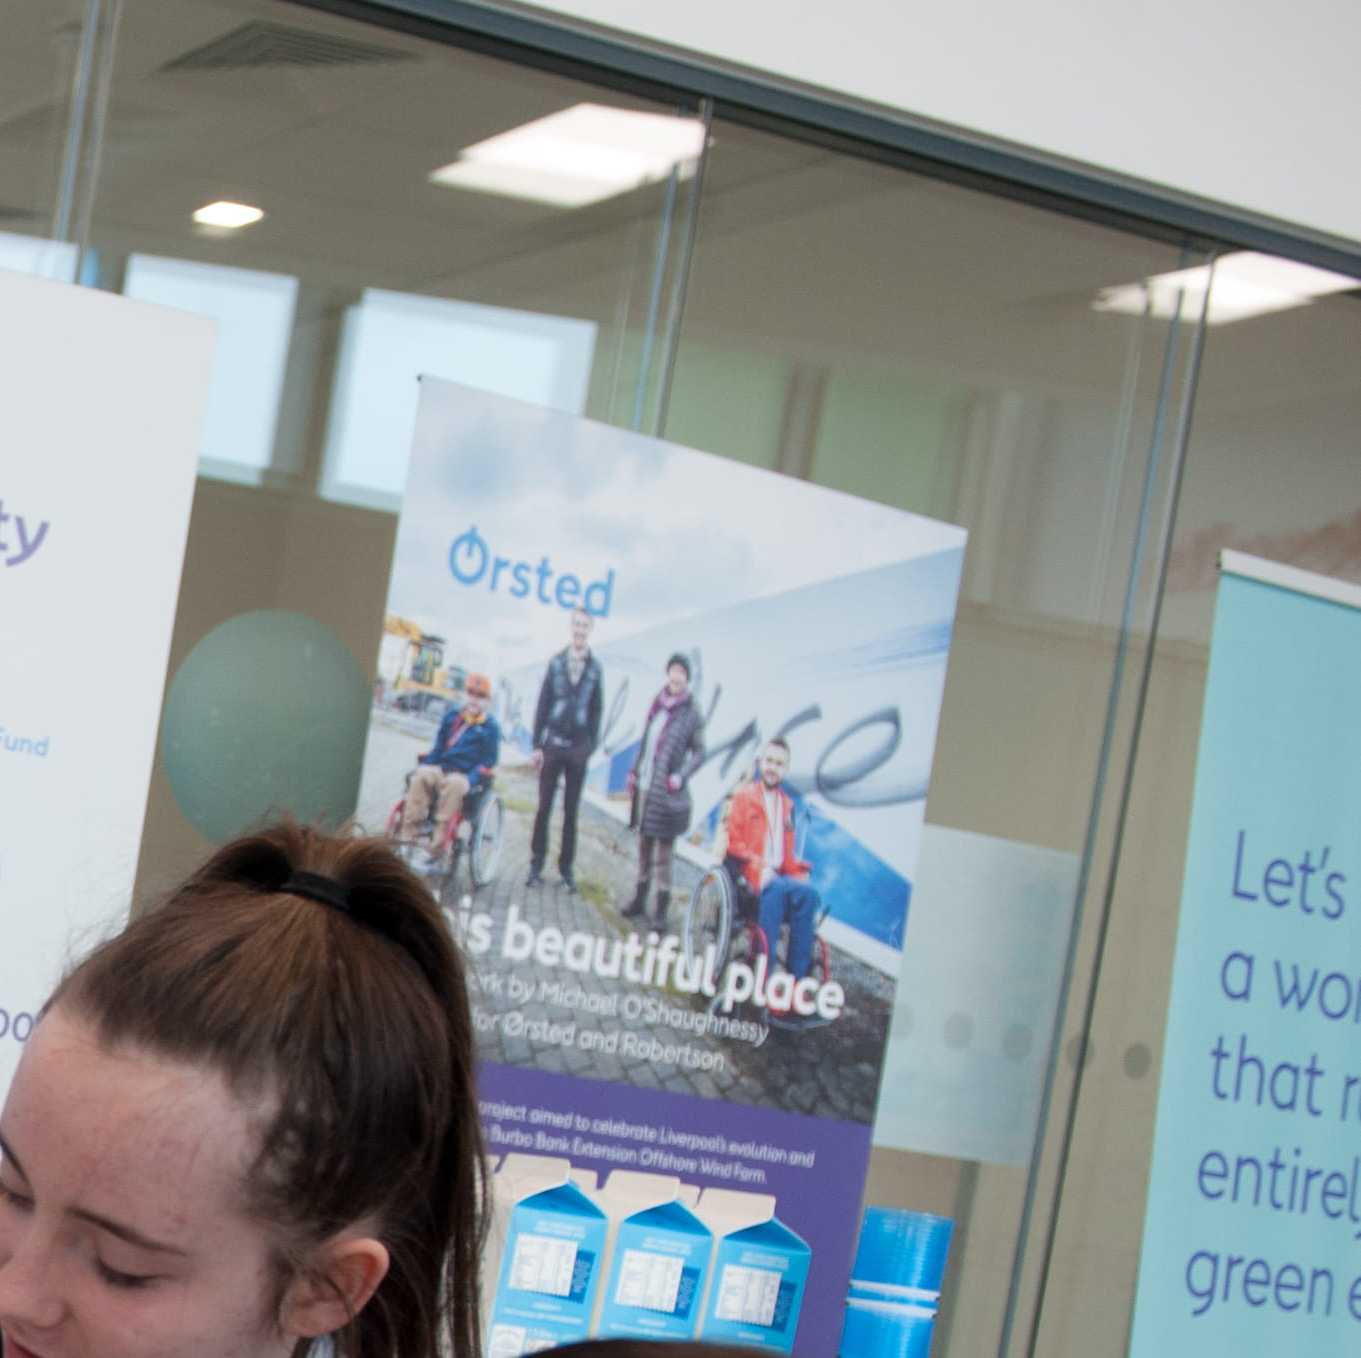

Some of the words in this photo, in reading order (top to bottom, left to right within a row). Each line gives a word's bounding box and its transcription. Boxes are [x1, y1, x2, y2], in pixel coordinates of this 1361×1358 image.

[1231, 830, 1346, 920] Let's
[502, 905, 716, 997] beautiful
[721, 954, 845, 1020] place
[1220, 951, 1255, 1002] a
[510, 973, 536, 1004] by
[541, 981, 618, 1017] Michael
[622, 993, 770, 1048] O'Shaughnessy
[579, 1022, 617, 1055] and
[623, 1036, 725, 1072] Robertson
[1210, 1034, 1324, 1117] that
[490, 1124, 533, 1148] Burbo
[535, 1131, 571, 1152] Bank
[573, 1137, 637, 1163] Extension
[639, 1147, 697, 1173] Offshore
[699, 1158, 732, 1180] Wind
[592, 1118, 657, 1142] celebrate
[728, 1139, 786, 1162] evolution
[789, 1150, 816, 1168] and
[1197, 1147, 1361, 1240] entirel
[1185, 1249, 1334, 1317] green
